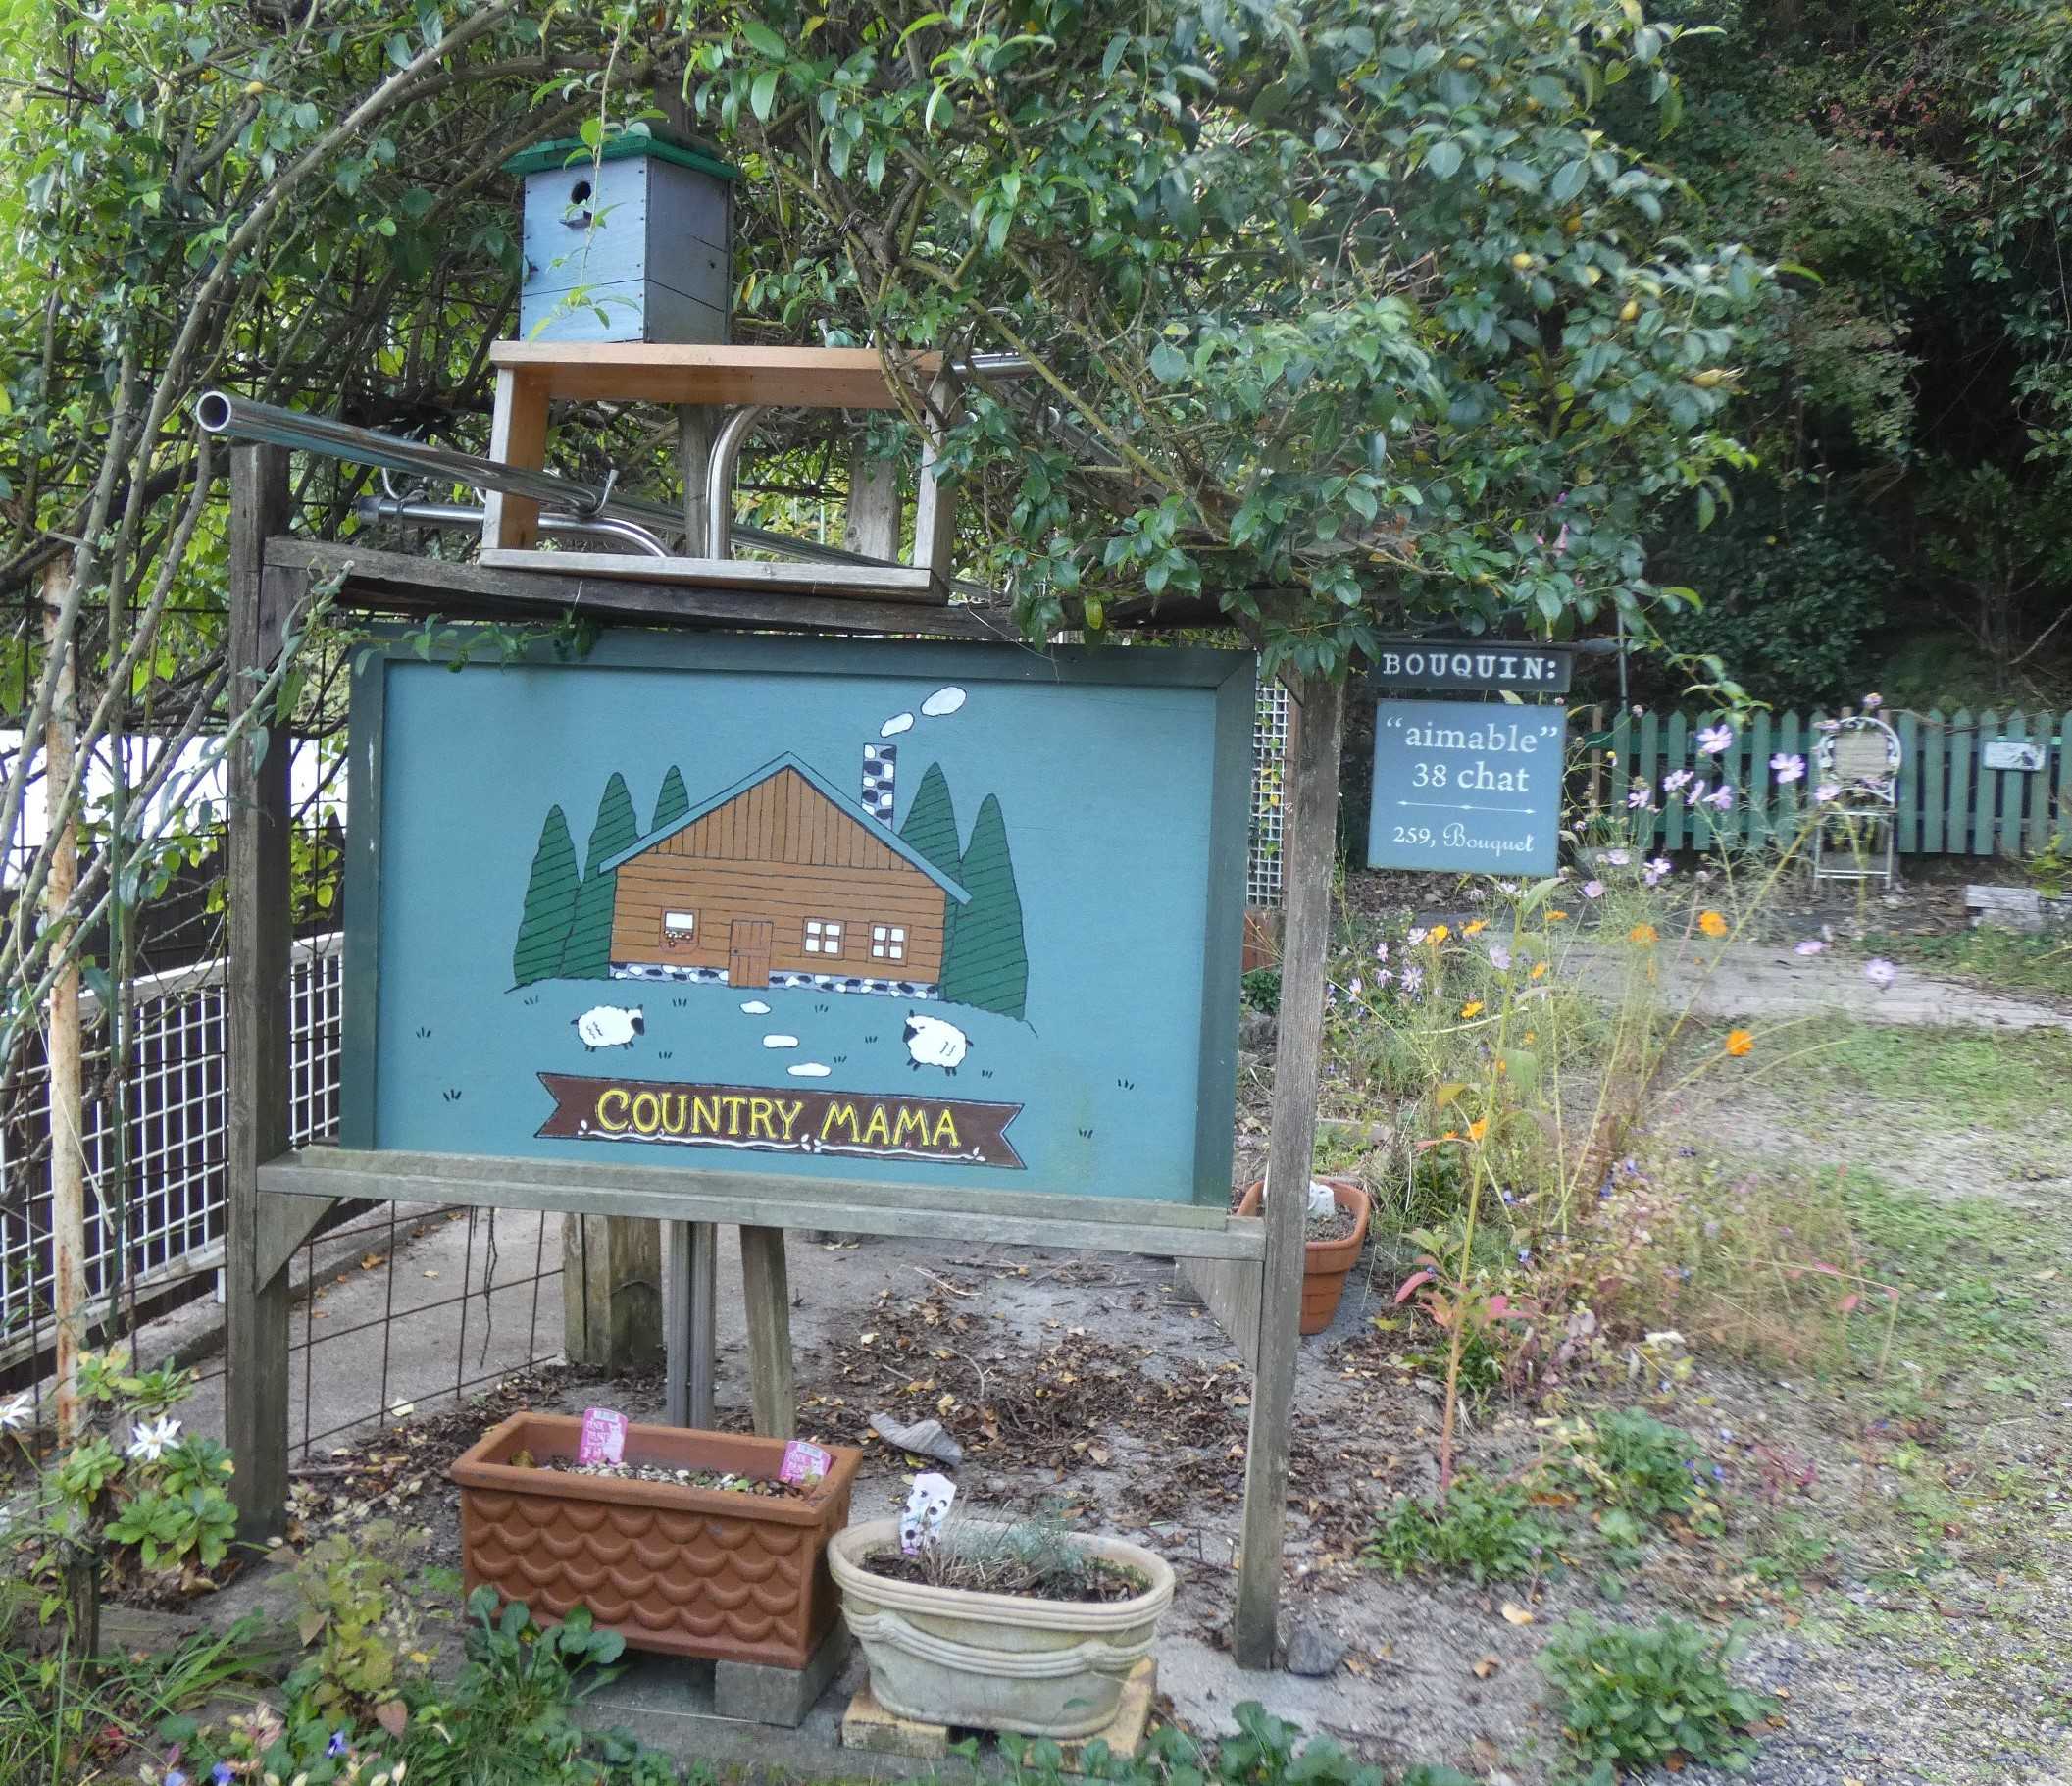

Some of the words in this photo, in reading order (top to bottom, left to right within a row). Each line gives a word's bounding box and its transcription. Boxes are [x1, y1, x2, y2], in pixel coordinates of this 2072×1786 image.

[1382, 653, 1557, 680] BOUQUIN:
[1386, 717, 1558, 753] “aimable”
[1412, 763, 1447, 788] 38
[1457, 761, 1530, 792] chat
[1392, 827, 1437, 848] 259,
[1442, 822, 1535, 857] Bouquet
[594, 1088, 803, 1140] COUNTRY
[820, 1100, 962, 1148] MAMA
